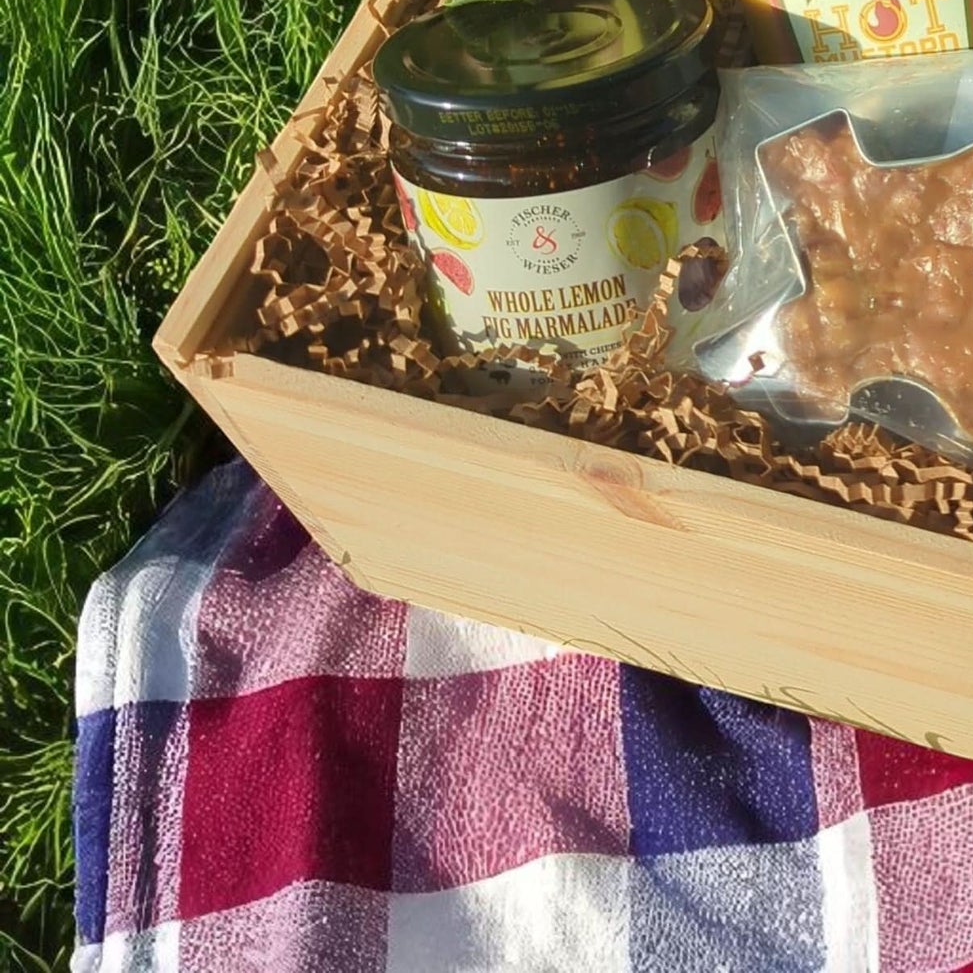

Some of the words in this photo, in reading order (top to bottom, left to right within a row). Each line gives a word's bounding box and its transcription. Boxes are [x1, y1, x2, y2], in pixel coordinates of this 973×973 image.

[511, 204, 571, 227] FISCHER
[532, 225, 557, 256] &
[523, 253, 579, 275] WIESER
[487, 290, 555, 314] WHOLE
[560, 274, 627, 310] LEMON
[482, 315, 512, 340] FIG
